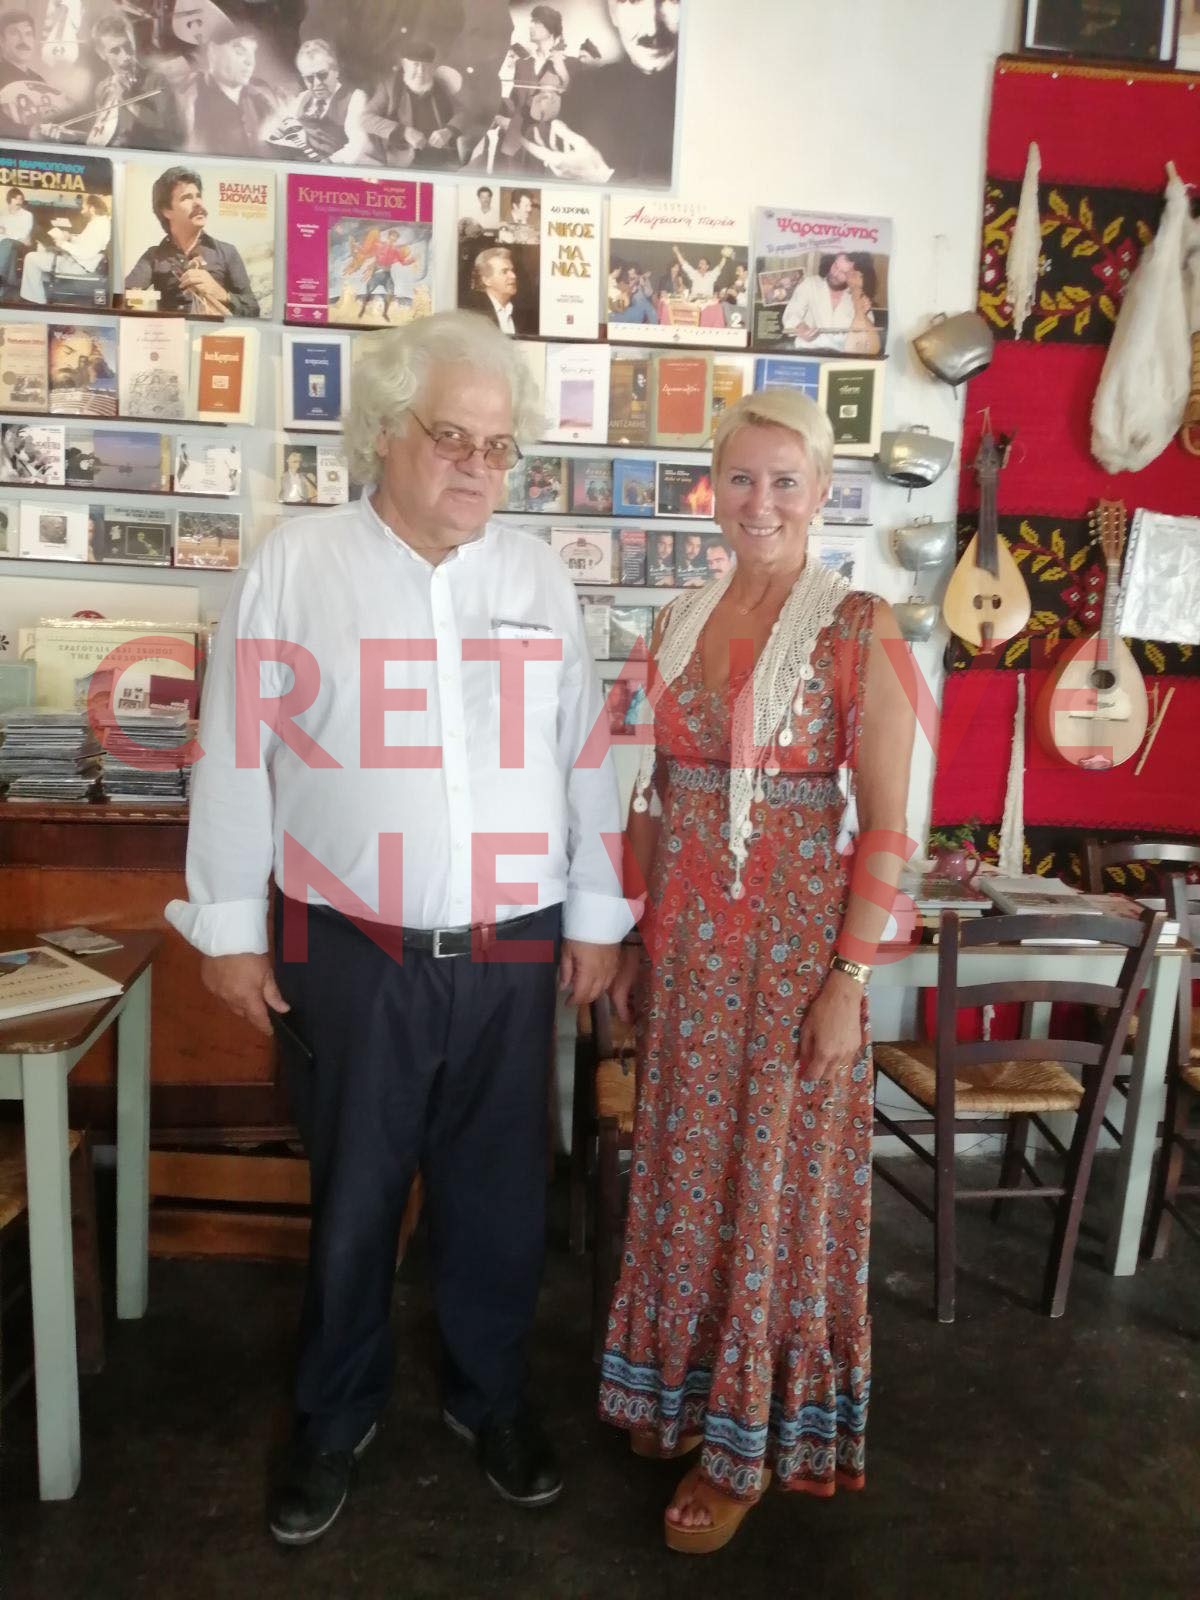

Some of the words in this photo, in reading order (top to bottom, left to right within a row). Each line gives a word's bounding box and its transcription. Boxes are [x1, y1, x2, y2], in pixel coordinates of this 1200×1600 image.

[219, 182, 267, 194] ΒΑΣΙΛΗΣ
[219, 192, 267, 204] ΣΚΟΥΛΑΣ
[547, 221, 594, 239] ΝΙΚΟΣ
[776, 217, 878, 243] Ψαραντώνης
[558, 245, 584, 261] ΜΑ
[551, 260, 591, 278] ΝΙΑΣ
[730, 312, 742, 328] 2
